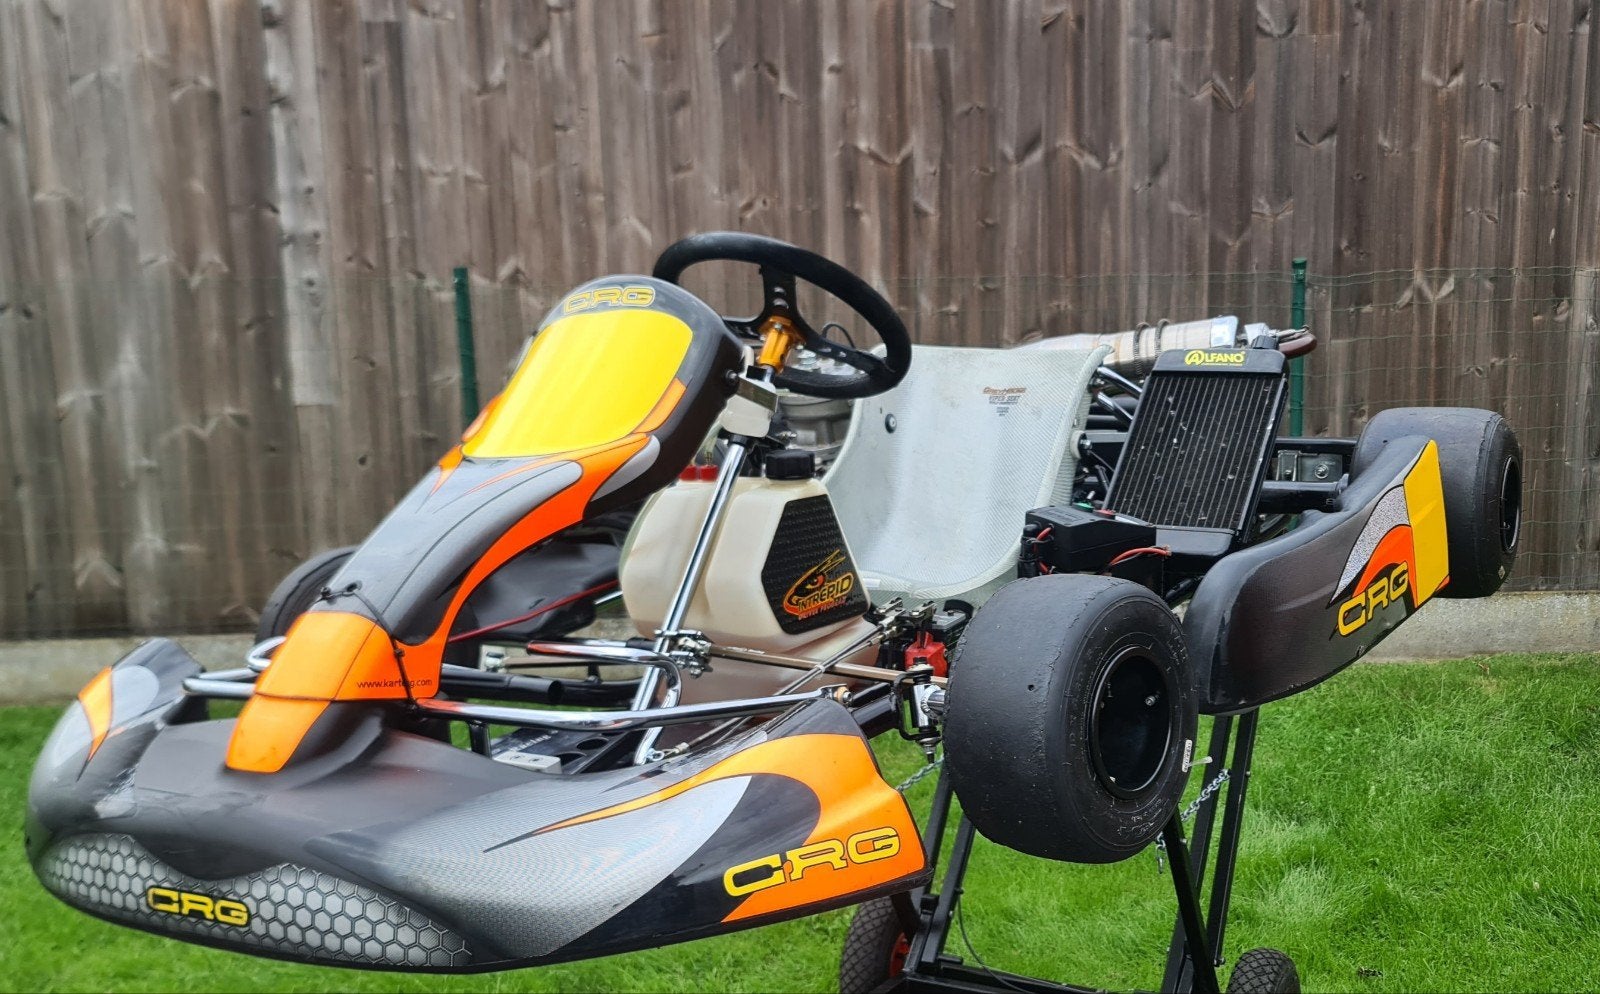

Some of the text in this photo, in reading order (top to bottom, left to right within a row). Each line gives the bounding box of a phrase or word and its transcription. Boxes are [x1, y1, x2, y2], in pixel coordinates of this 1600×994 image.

[563, 286, 655, 315] CRG
[798, 573, 853, 612] INTREPID
[1338, 560, 1409, 636] CRG
[356, 679, 433, 688] www.kartg.com
[723, 826, 901, 897] CRG
[147, 886, 249, 927] CRG
